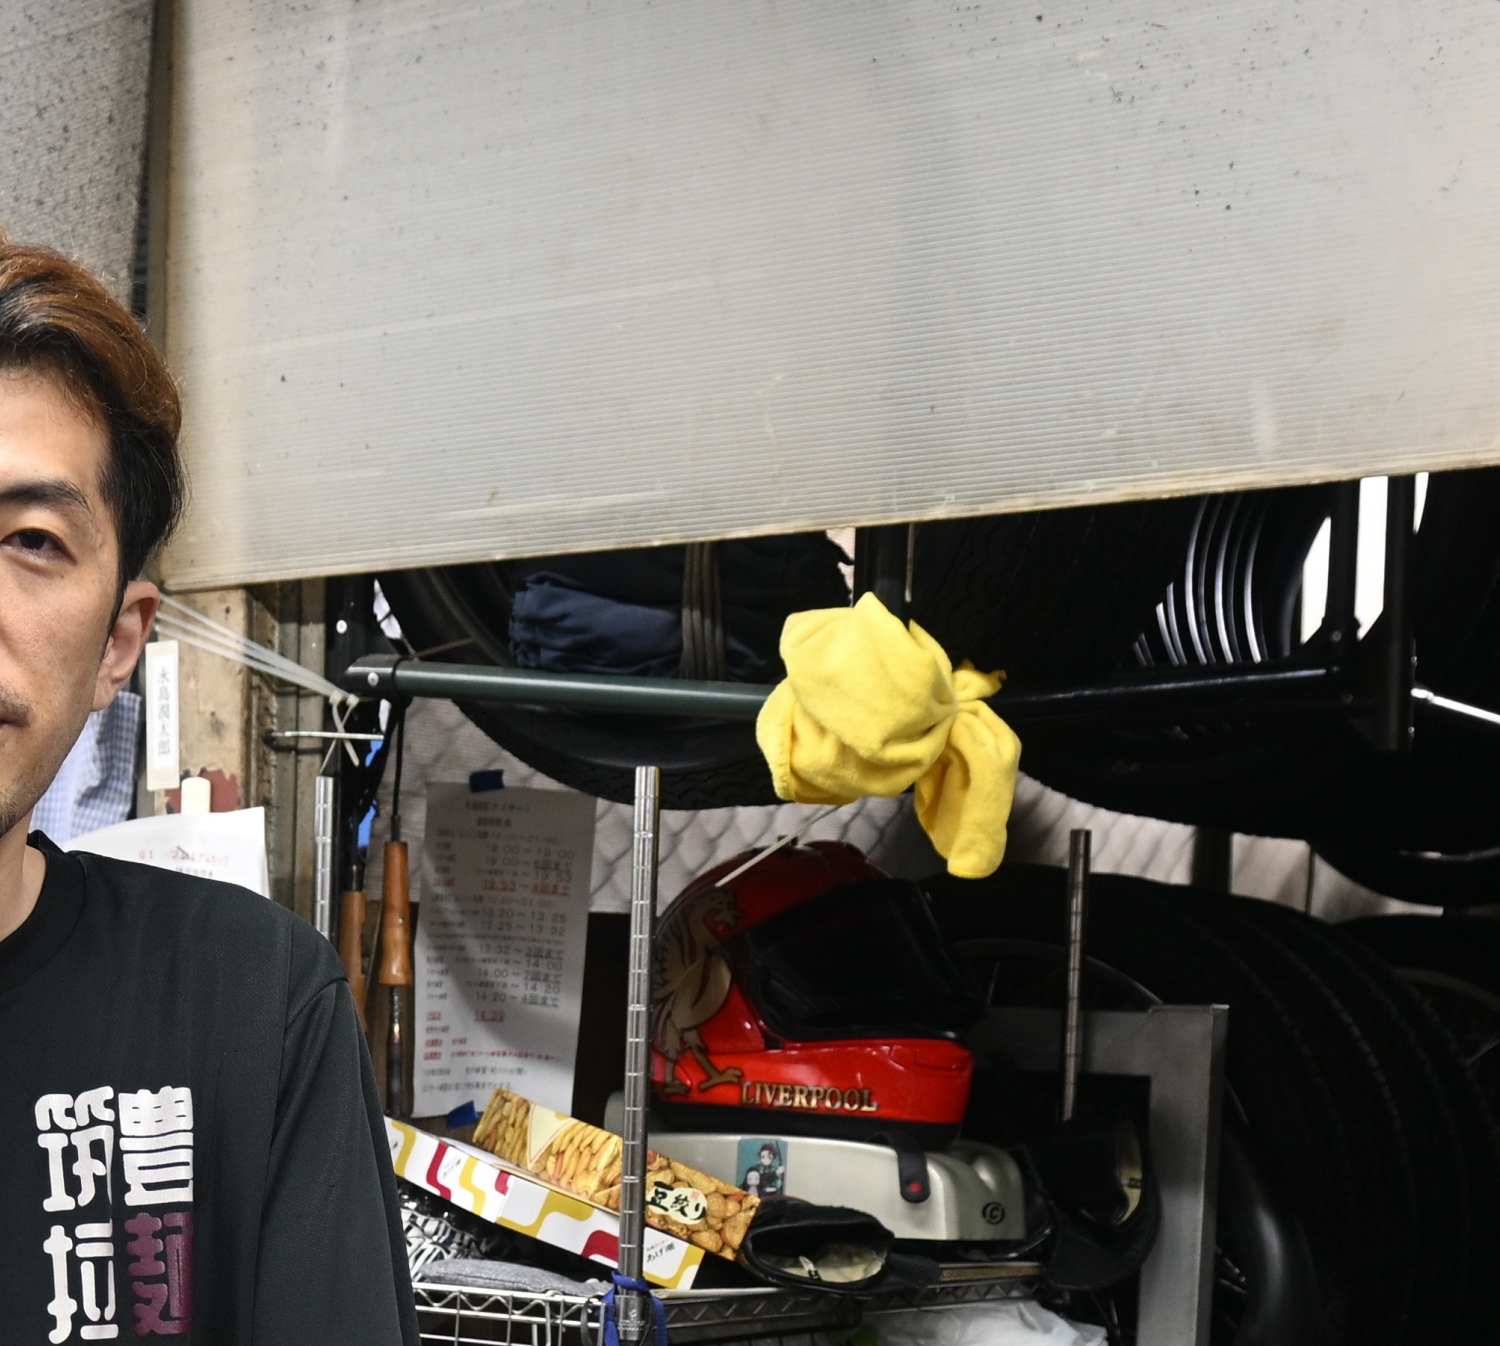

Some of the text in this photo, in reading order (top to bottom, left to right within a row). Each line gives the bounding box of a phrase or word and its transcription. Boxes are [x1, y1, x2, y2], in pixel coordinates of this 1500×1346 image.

[741, 1080, 879, 1113] LIVERPOOL
[645, 1180, 707, 1221] 豆絞り
